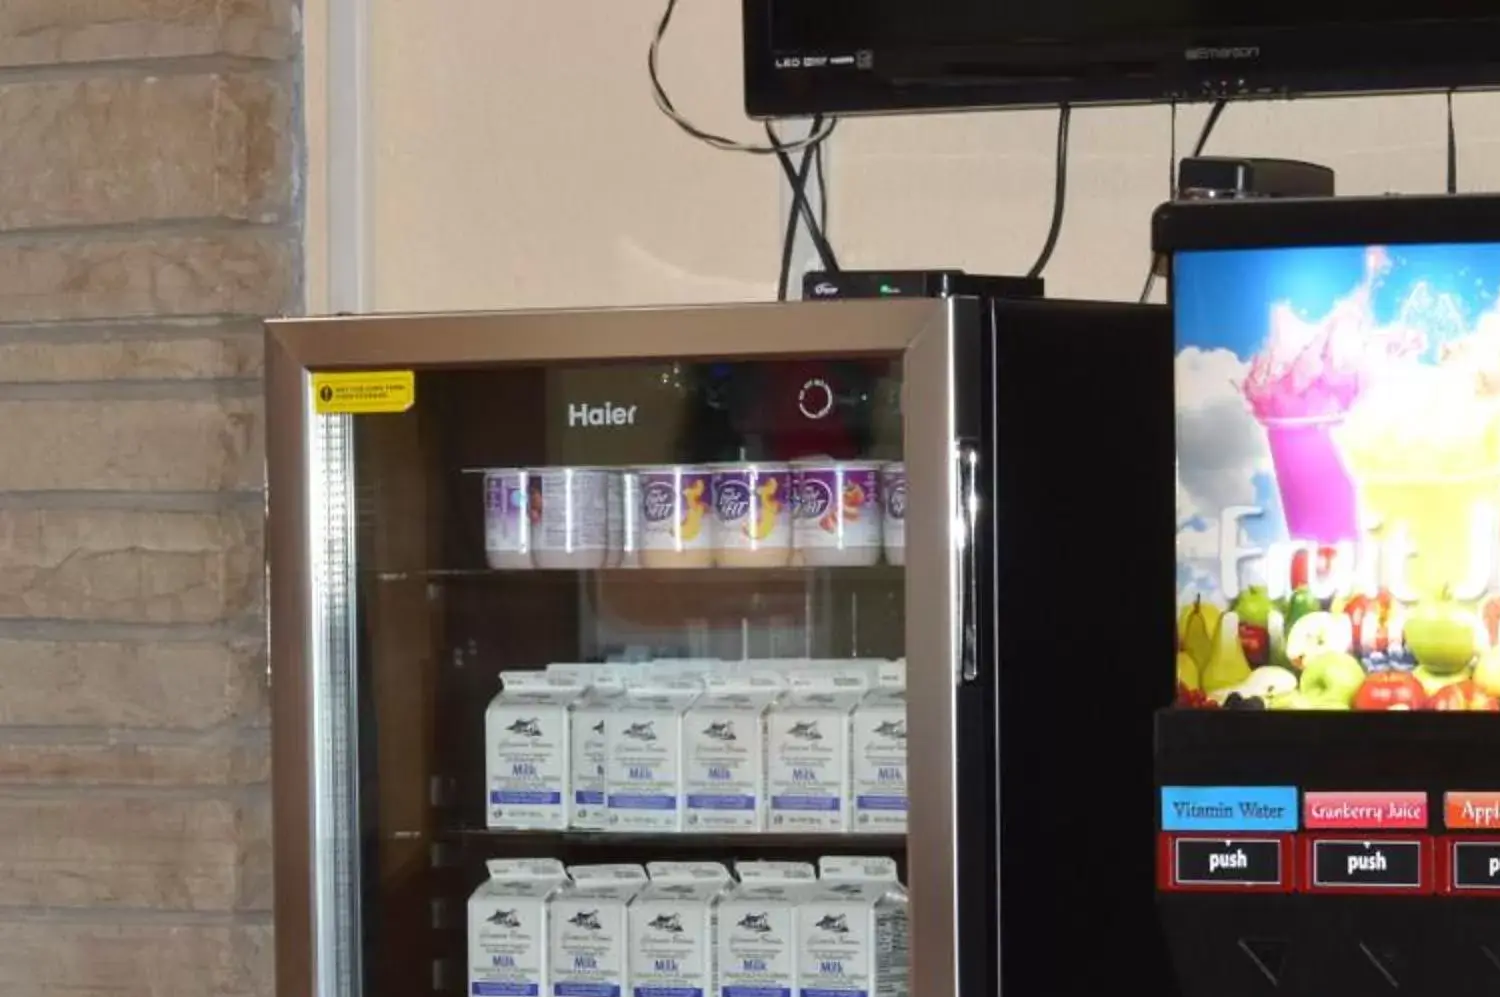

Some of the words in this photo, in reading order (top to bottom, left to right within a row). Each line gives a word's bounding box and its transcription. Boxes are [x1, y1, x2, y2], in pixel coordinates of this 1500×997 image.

[774, 57, 801, 69] LED
[568, 402, 637, 427] Haier
[1217, 504, 1420, 602] Fruit
[1172, 801, 1233, 818] Vitamin
[1238, 801, 1286, 818] Water
[1311, 802, 1383, 822] Cranberry
[1386, 802, 1421, 820] Juice
[1208, 848, 1248, 873] push
[1347, 851, 1387, 875] push
